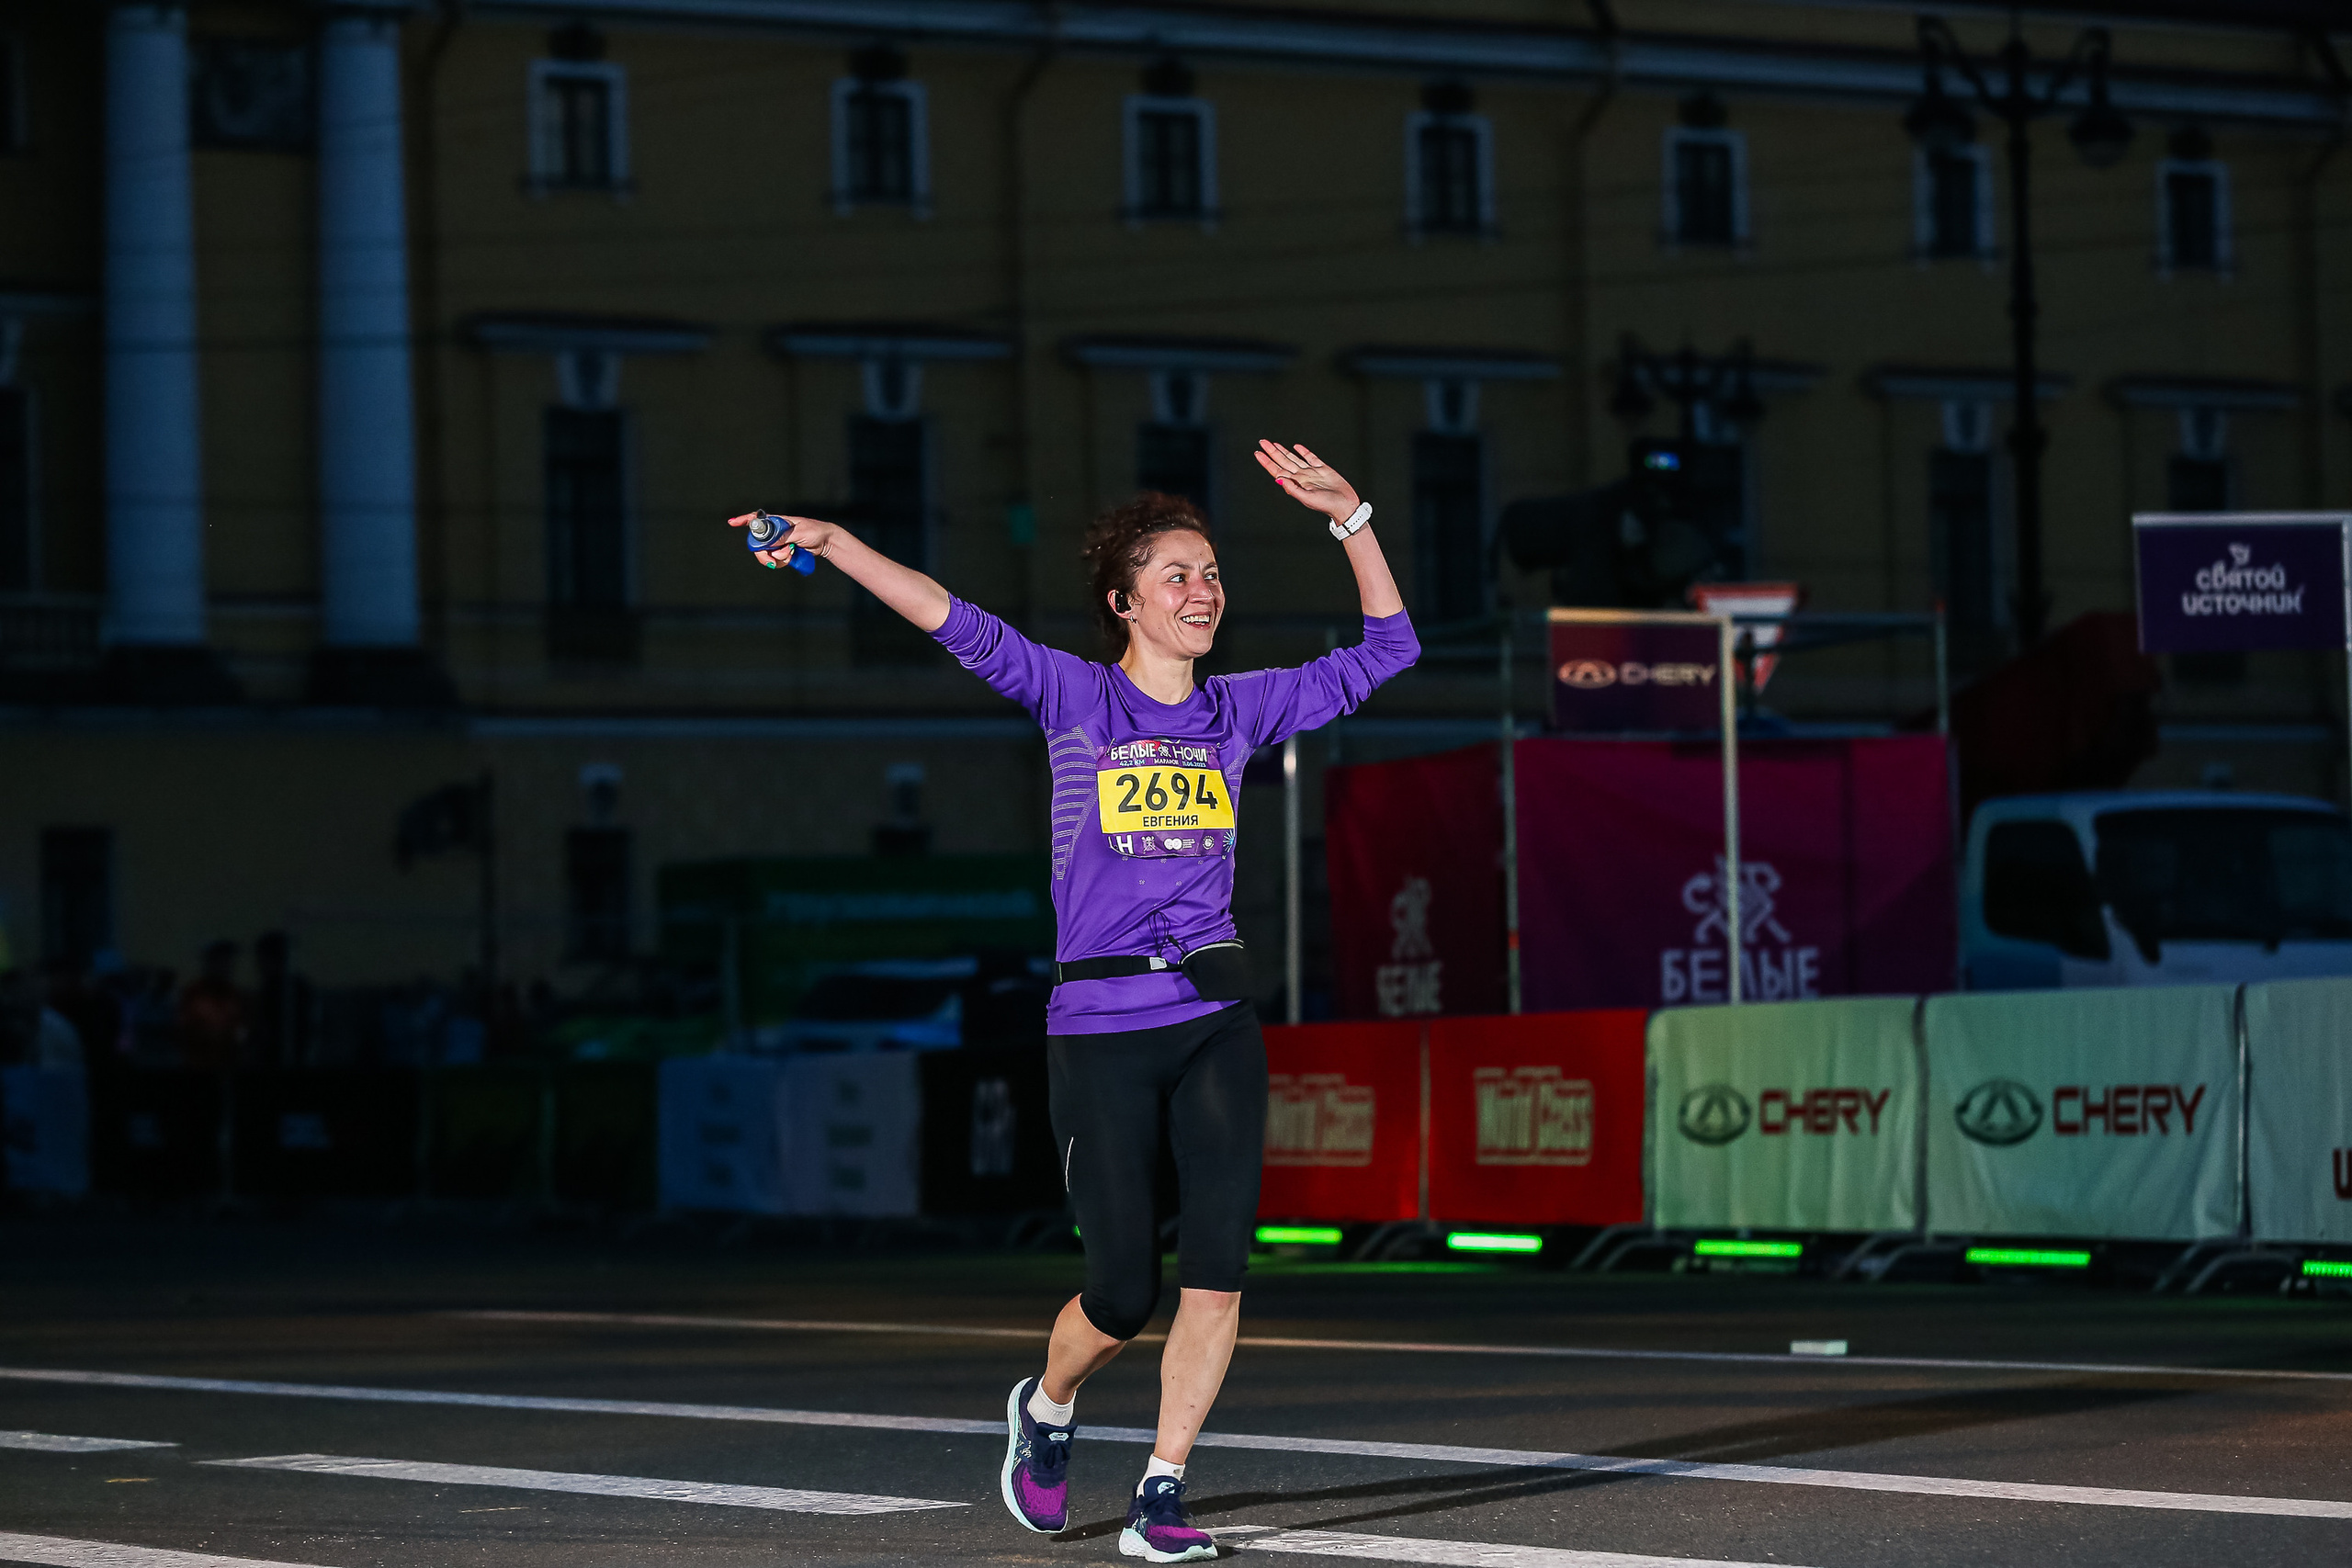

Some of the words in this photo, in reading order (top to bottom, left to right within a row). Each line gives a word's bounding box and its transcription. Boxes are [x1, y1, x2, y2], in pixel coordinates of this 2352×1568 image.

[1110, 742, 1157, 761] БЕЛЫЕ
[1172, 745, 1208, 762] НОЧИ
[1115, 773, 1218, 813] 2694
[1142, 815, 1199, 828] ЕВГЕНИЯ
[1759, 1087, 1892, 1136] CHERY
[2052, 1082, 2206, 1136] CHERY
